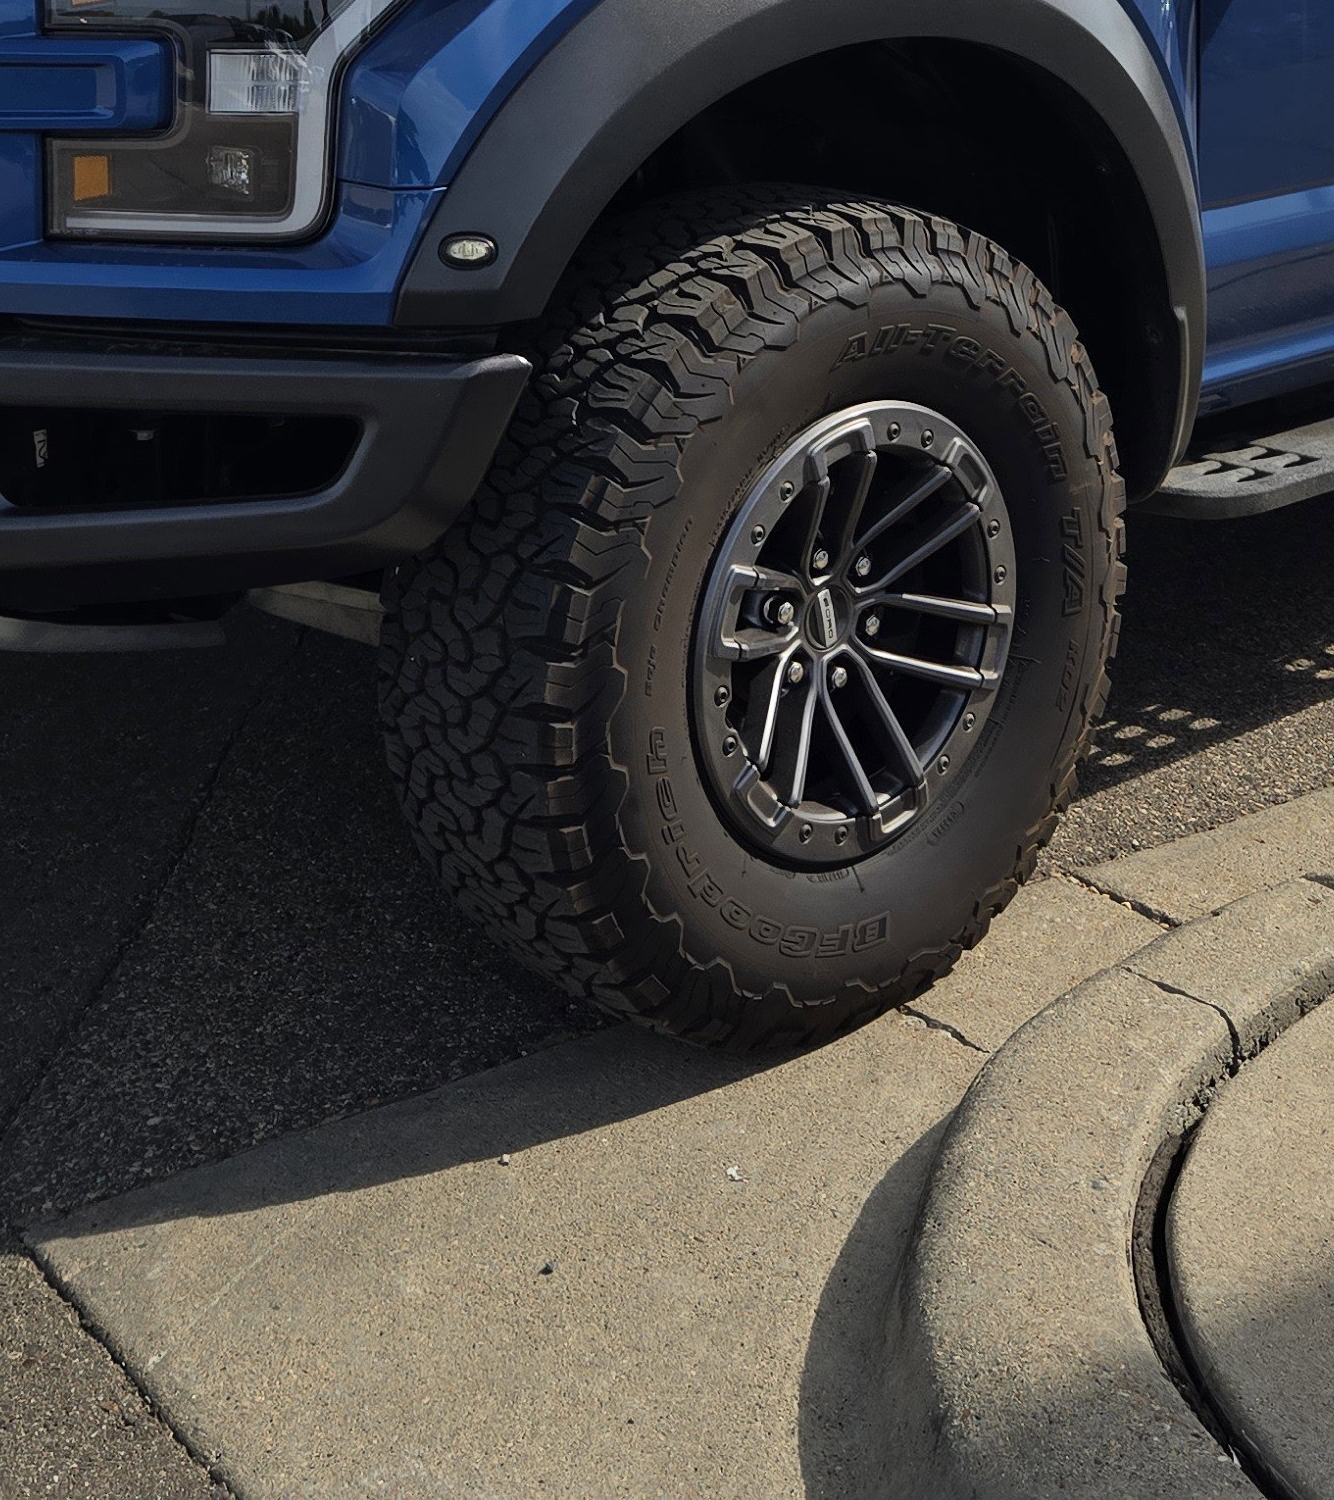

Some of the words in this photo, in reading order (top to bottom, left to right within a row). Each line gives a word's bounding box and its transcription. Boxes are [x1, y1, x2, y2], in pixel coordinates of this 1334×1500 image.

[829, 321, 1068, 482] All-Terrain
[1060, 506, 1087, 617] T/A
[822, 597, 834, 639] FORD
[645, 726, 892, 959] BFGoodrich
